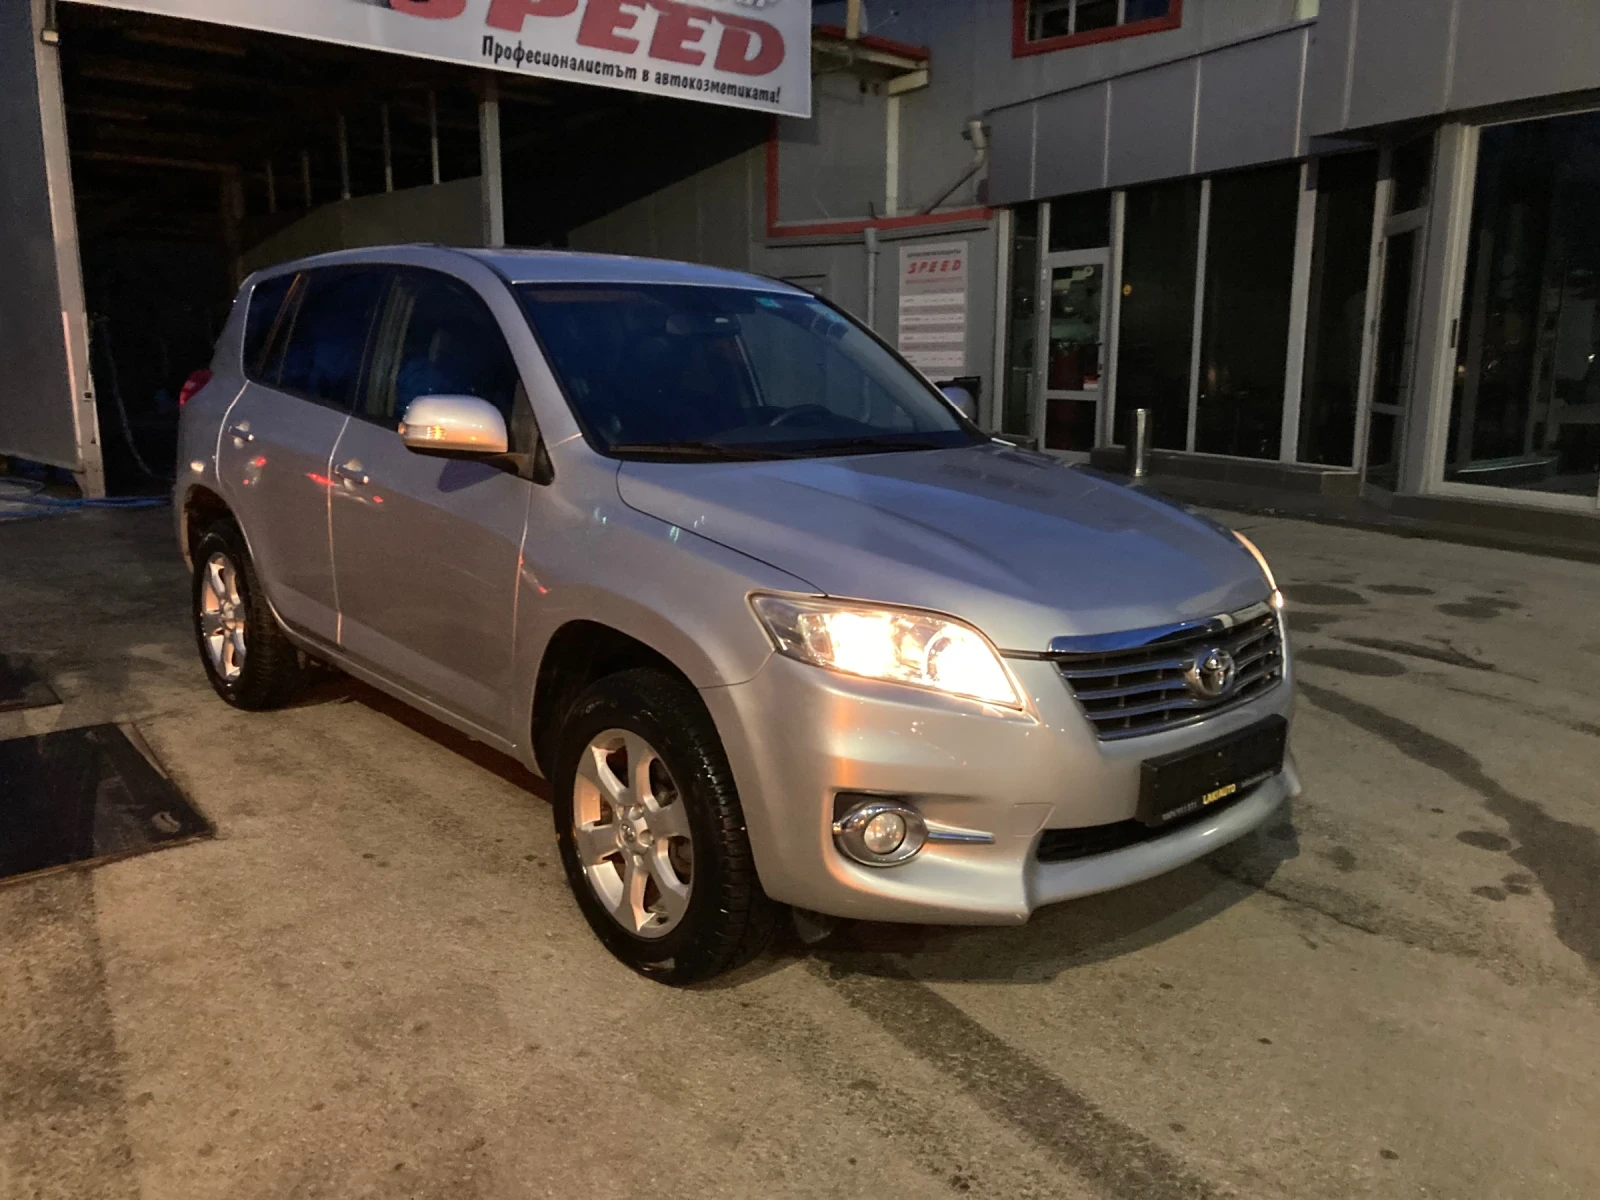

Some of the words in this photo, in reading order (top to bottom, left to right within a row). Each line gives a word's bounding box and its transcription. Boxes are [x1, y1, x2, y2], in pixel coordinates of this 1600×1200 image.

[481, 35, 637, 80] Професионалистът
[642, 69, 650, 82] в
[655, 72, 781, 104] автокозметиката!
[907, 260, 962, 275] SPEED
